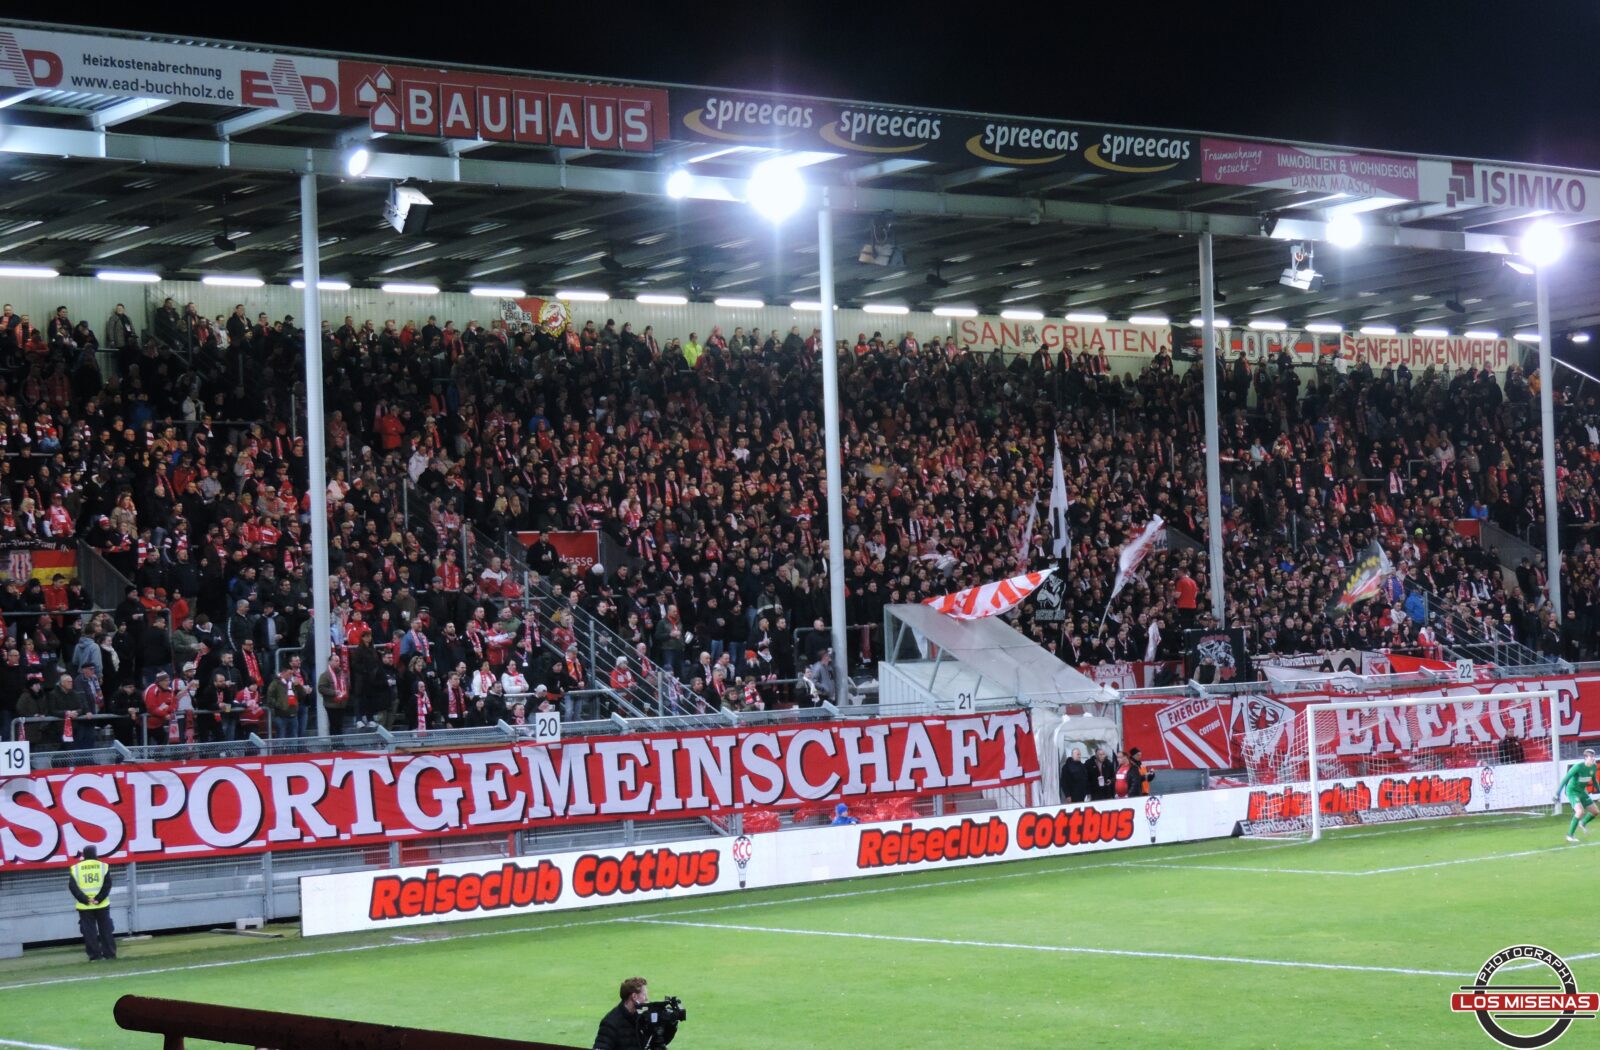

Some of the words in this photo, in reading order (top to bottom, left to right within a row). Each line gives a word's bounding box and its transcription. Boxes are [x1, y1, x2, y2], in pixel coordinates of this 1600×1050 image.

[83, 53, 222, 79] Heizkostenabrechnung
[71, 74, 235, 100] www.ead-buchholz.de
[240, 58, 337, 112] EAD
[408, 88, 649, 143] BAUHAUS
[1203, 147, 1263, 165] Traumwohnung
[1277, 152, 1337, 173] IMMOBILIEN
[1340, 161, 1348, 173] &
[1351, 160, 1416, 179] WOHNDESIGN
[1291, 175, 1326, 189] DIANA
[1330, 176, 1377, 195] MAASCH
[1343, 336, 1509, 367] SENFGURKENMAFIA
[558, 554, 594, 567] kasse
[1458, 664, 1472, 679] 22
[957, 693, 972, 710] 21
[1167, 698, 1210, 725] ENERGIE
[537, 718, 558, 737] 20
[1336, 679, 1582, 756] ENERGIE
[4, 747, 25, 769] 19
[1378, 774, 1473, 809] Cottbus
[1144, 801, 1161, 818] RCC
[1361, 805, 1413, 823] Eisenbach
[857, 815, 1008, 869] Reiseclub
[1017, 806, 1135, 850] Cottbus
[732, 841, 752, 859] RCC
[82, 872, 100, 884] 184
[369, 860, 563, 921] Reiseclub
[573, 848, 720, 898] Cottbus
